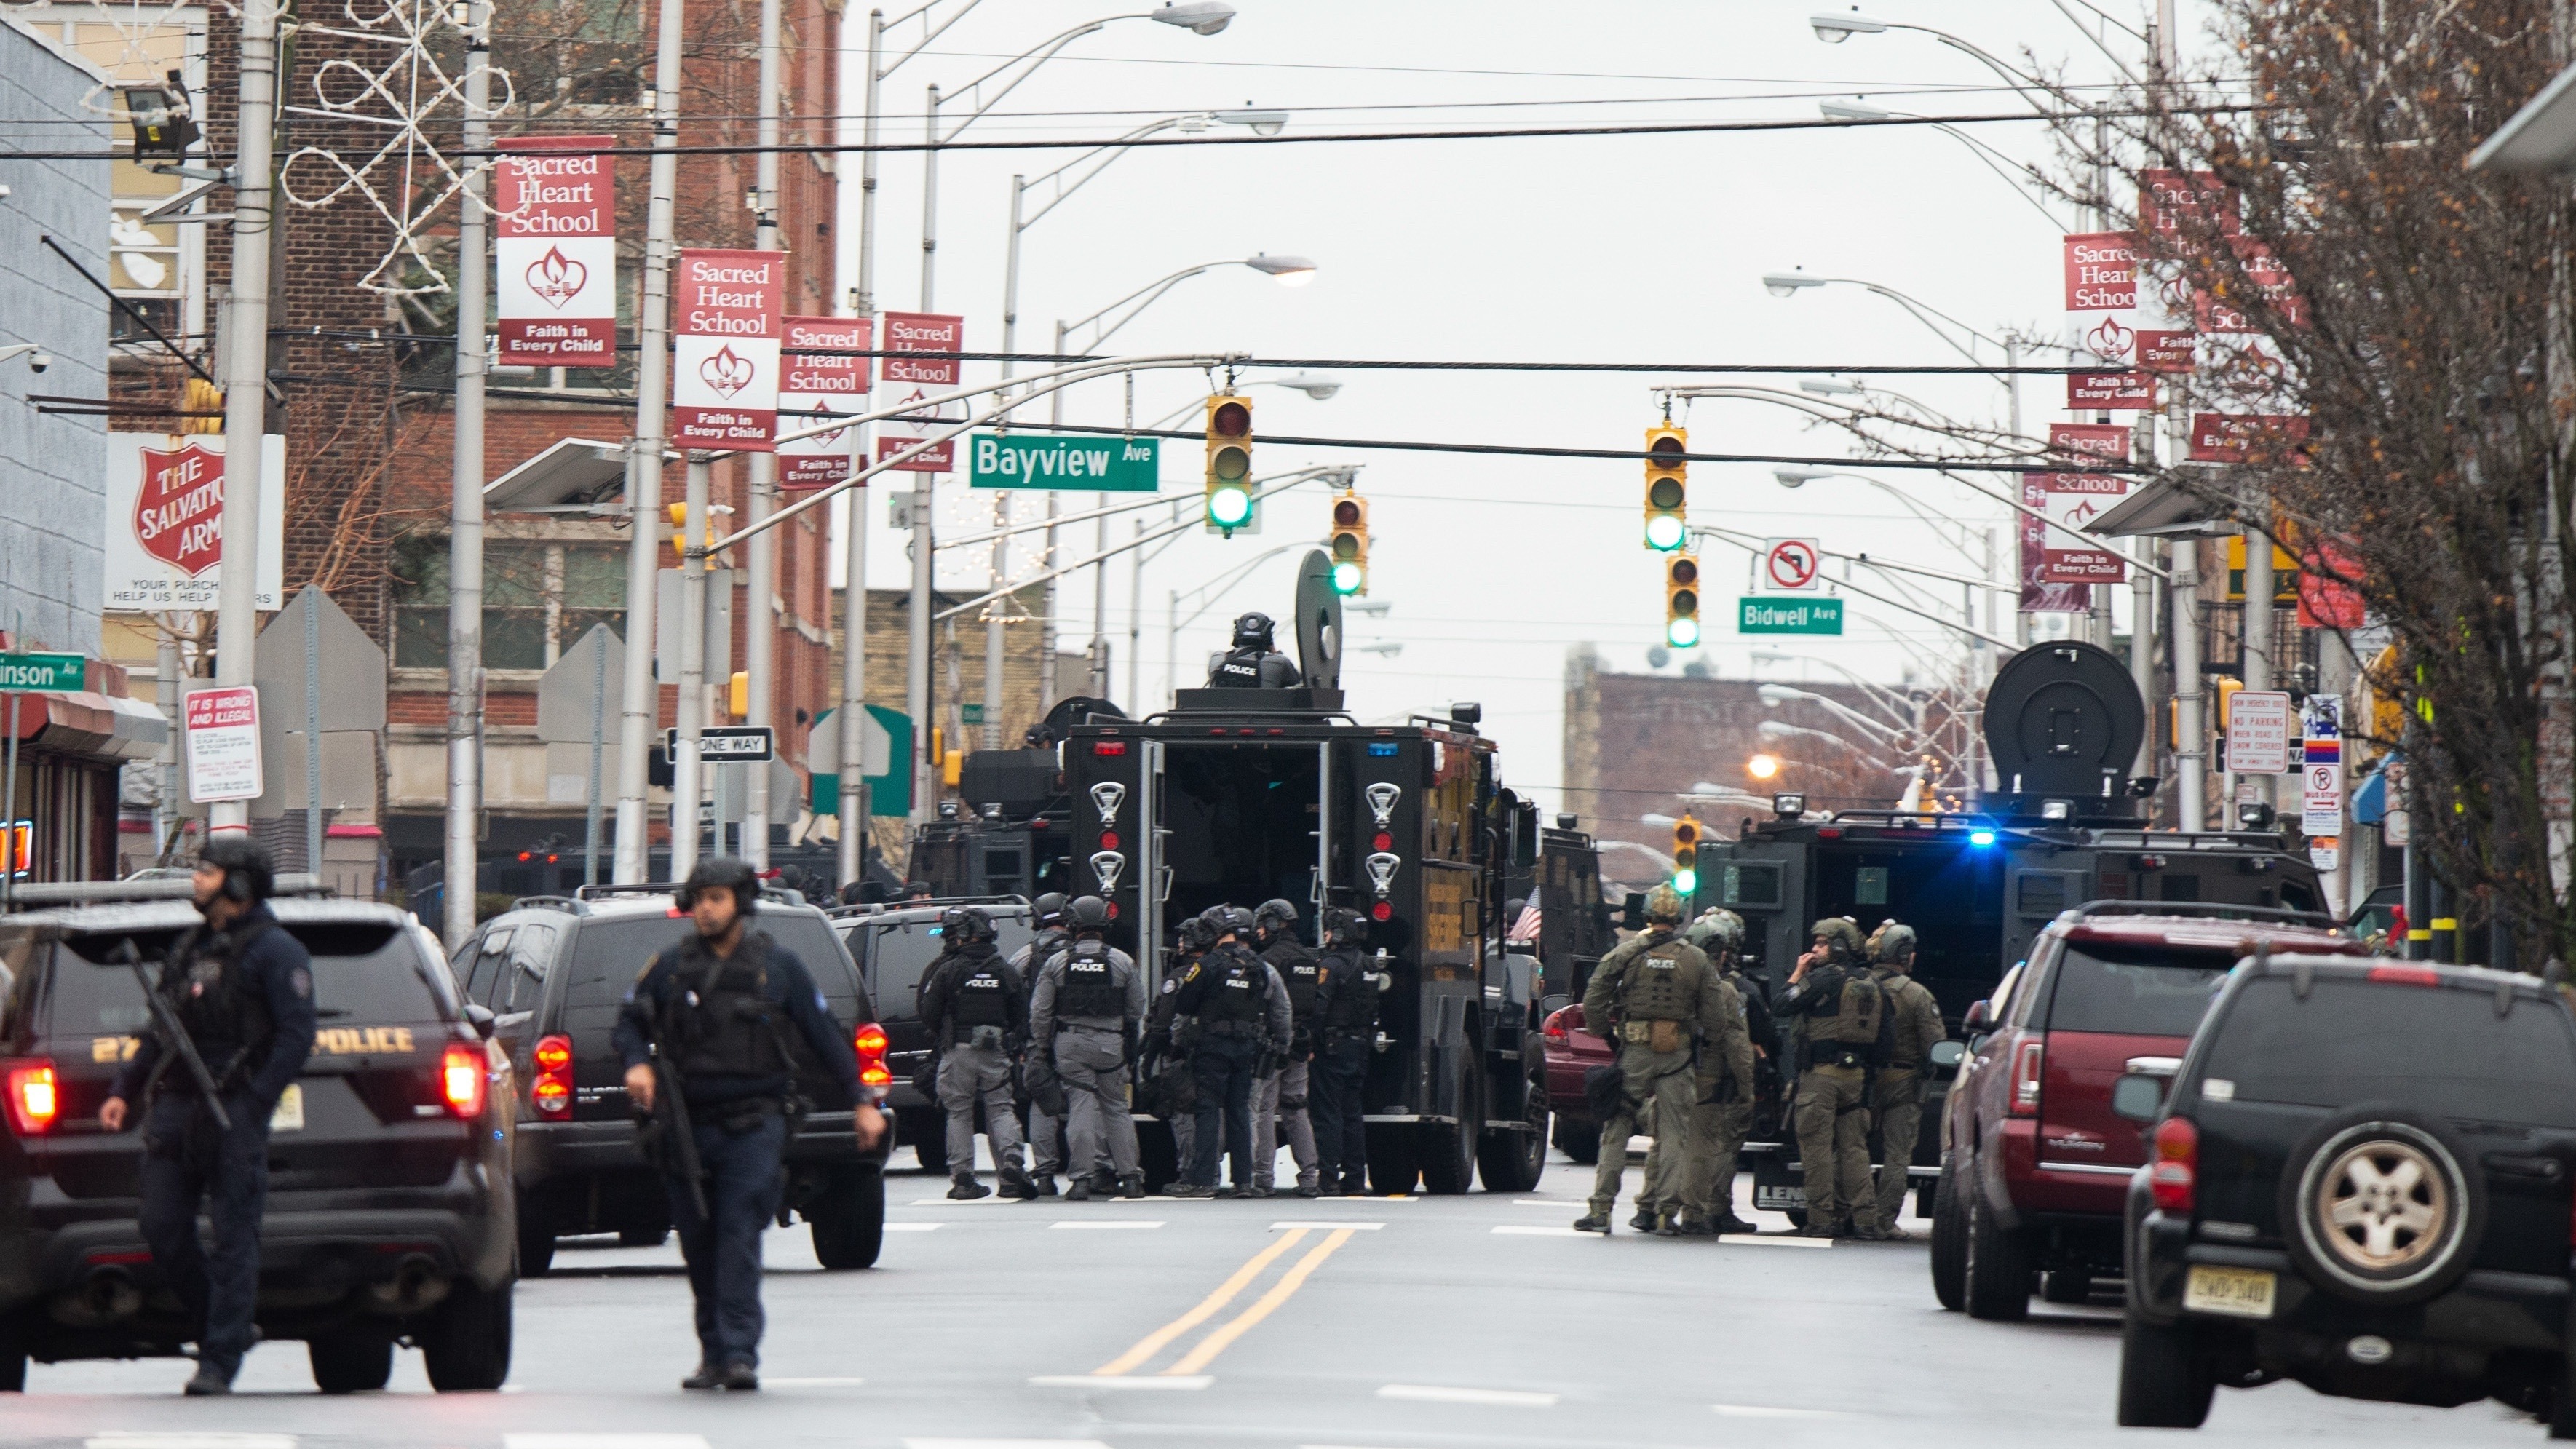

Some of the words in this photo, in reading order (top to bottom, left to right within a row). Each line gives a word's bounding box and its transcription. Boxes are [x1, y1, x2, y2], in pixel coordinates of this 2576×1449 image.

[511, 155, 598, 176] Sacred
[516, 181, 593, 204] Heart
[512, 208, 600, 233] School
[691, 261, 769, 285] Sacred
[2080, 266, 2137, 285] Hear
[697, 286, 764, 309] Heart
[2075, 288, 2136, 307] Schoo
[690, 311, 767, 334] School
[526, 325, 568, 338] Faith
[572, 325, 588, 337] in
[792, 327, 860, 346] Sacred
[892, 322, 954, 341] Sacred
[510, 340, 557, 353] Every
[560, 340, 603, 352] Child
[796, 354, 853, 368] Heart
[890, 362, 951, 381] School
[790, 372, 856, 391] School
[2088, 378, 2120, 387] Faith
[2076, 389, 2112, 400] Every
[697, 413, 735, 425] Faith
[738, 415, 753, 425] in
[684, 426, 725, 438] Every
[728, 426, 766, 438] Child
[2058, 433, 2119, 452] Sacred
[799, 460, 833, 469] Faith
[836, 460, 848, 469] in
[978, 440, 1110, 484] Bayview
[1122, 443, 1152, 461] Ave
[156, 456, 204, 495] THE
[788, 471, 823, 481] Every
[826, 470, 849, 479] Chi
[2056, 473, 2118, 491] School
[141, 476, 225, 540] SALVATIO
[177, 512, 223, 560] ARM
[2064, 555, 2093, 563] Faith
[2096, 555, 2107, 563] in
[2053, 565, 2085, 575] Every
[2088, 564, 2117, 573] Child
[132, 579, 167, 590] YOUR
[175, 580, 219, 591] PURCH
[114, 591, 147, 601] HELP
[154, 592, 171, 602] US
[179, 592, 211, 602] HELP
[1745, 605, 1808, 625] Bidwell
[1813, 607, 1836, 619] Ave
[1224, 664, 1256, 676] POLICE
[189, 699, 199, 711] IT
[201, 698, 213, 710] IS
[215, 694, 252, 709] WRONG
[190, 712, 213, 725] AND
[214, 710, 252, 723] ILLEGAL
[2234, 717, 2244, 726] NO
[2249, 718, 2283, 726] PARKING
[700, 738, 726, 751] ONE
[732, 737, 761, 750] WAY
[1071, 963, 1105, 972] POLICE
[1293, 966, 1316, 974] POLICE
[1647, 959, 1676, 969] POLICE
[1226, 979, 1250, 988] POLICE
[1758, 1186, 1806, 1200] LEN
